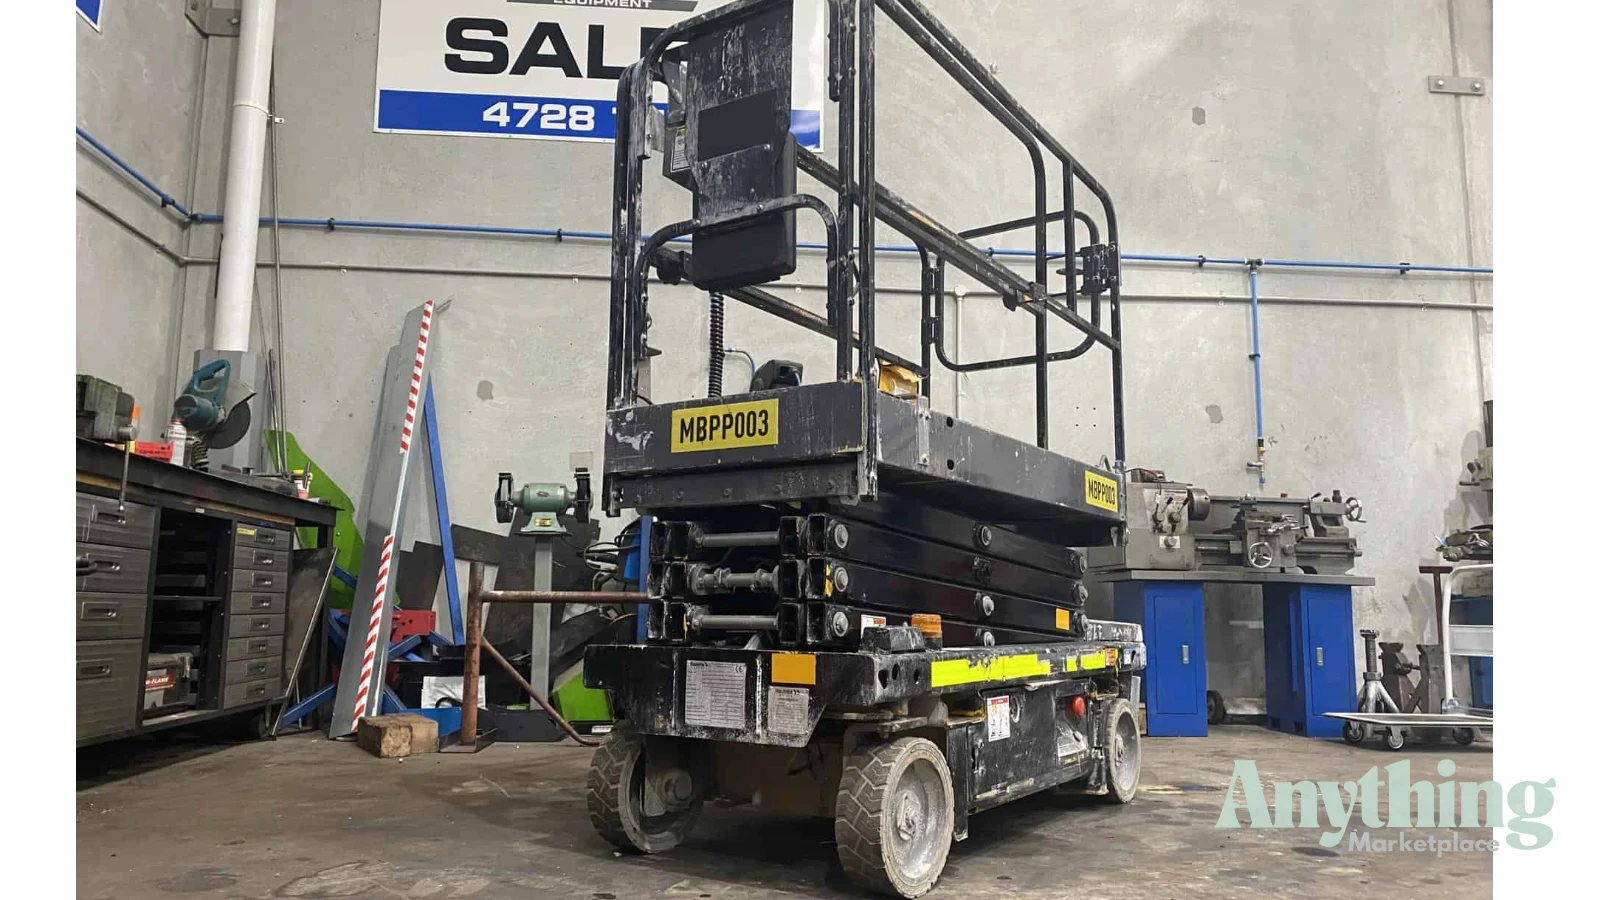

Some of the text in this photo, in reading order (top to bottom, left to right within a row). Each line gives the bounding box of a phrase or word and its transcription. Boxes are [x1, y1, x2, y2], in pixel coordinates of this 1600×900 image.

[482, 101, 595, 131] 4728
[680, 409, 769, 444] MBPP003
[1088, 478, 1115, 505] MBPP003
